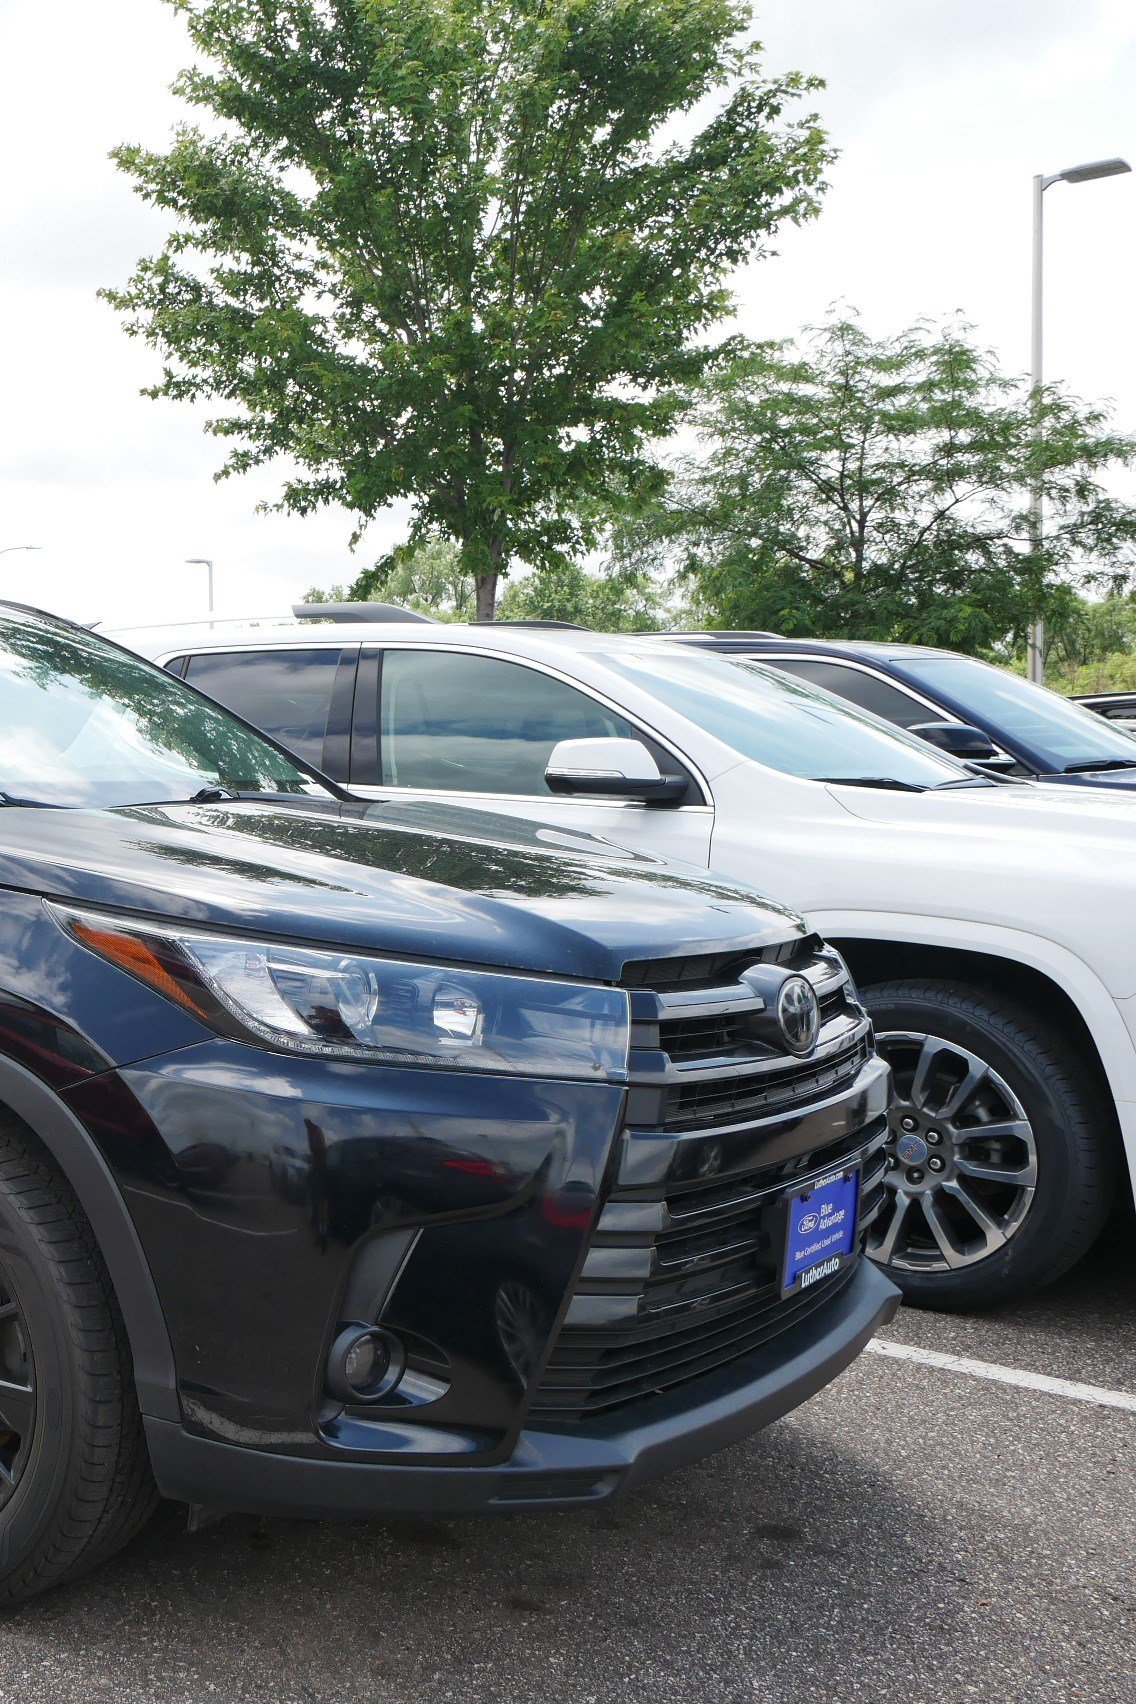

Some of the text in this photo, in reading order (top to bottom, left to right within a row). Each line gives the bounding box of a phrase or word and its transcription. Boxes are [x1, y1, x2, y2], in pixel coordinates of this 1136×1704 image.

[901, 1141, 920, 1159] GMC
[814, 1171, 844, 1190] LutherAuto.com
[821, 1203, 833, 1216] Blue
[801, 1215, 816, 1232] Ford
[818, 1209, 845, 1231] Advantage
[795, 1230, 844, 1260] Blue Certified Used Vehicle
[801, 1257, 840, 1288] LutherAuto
